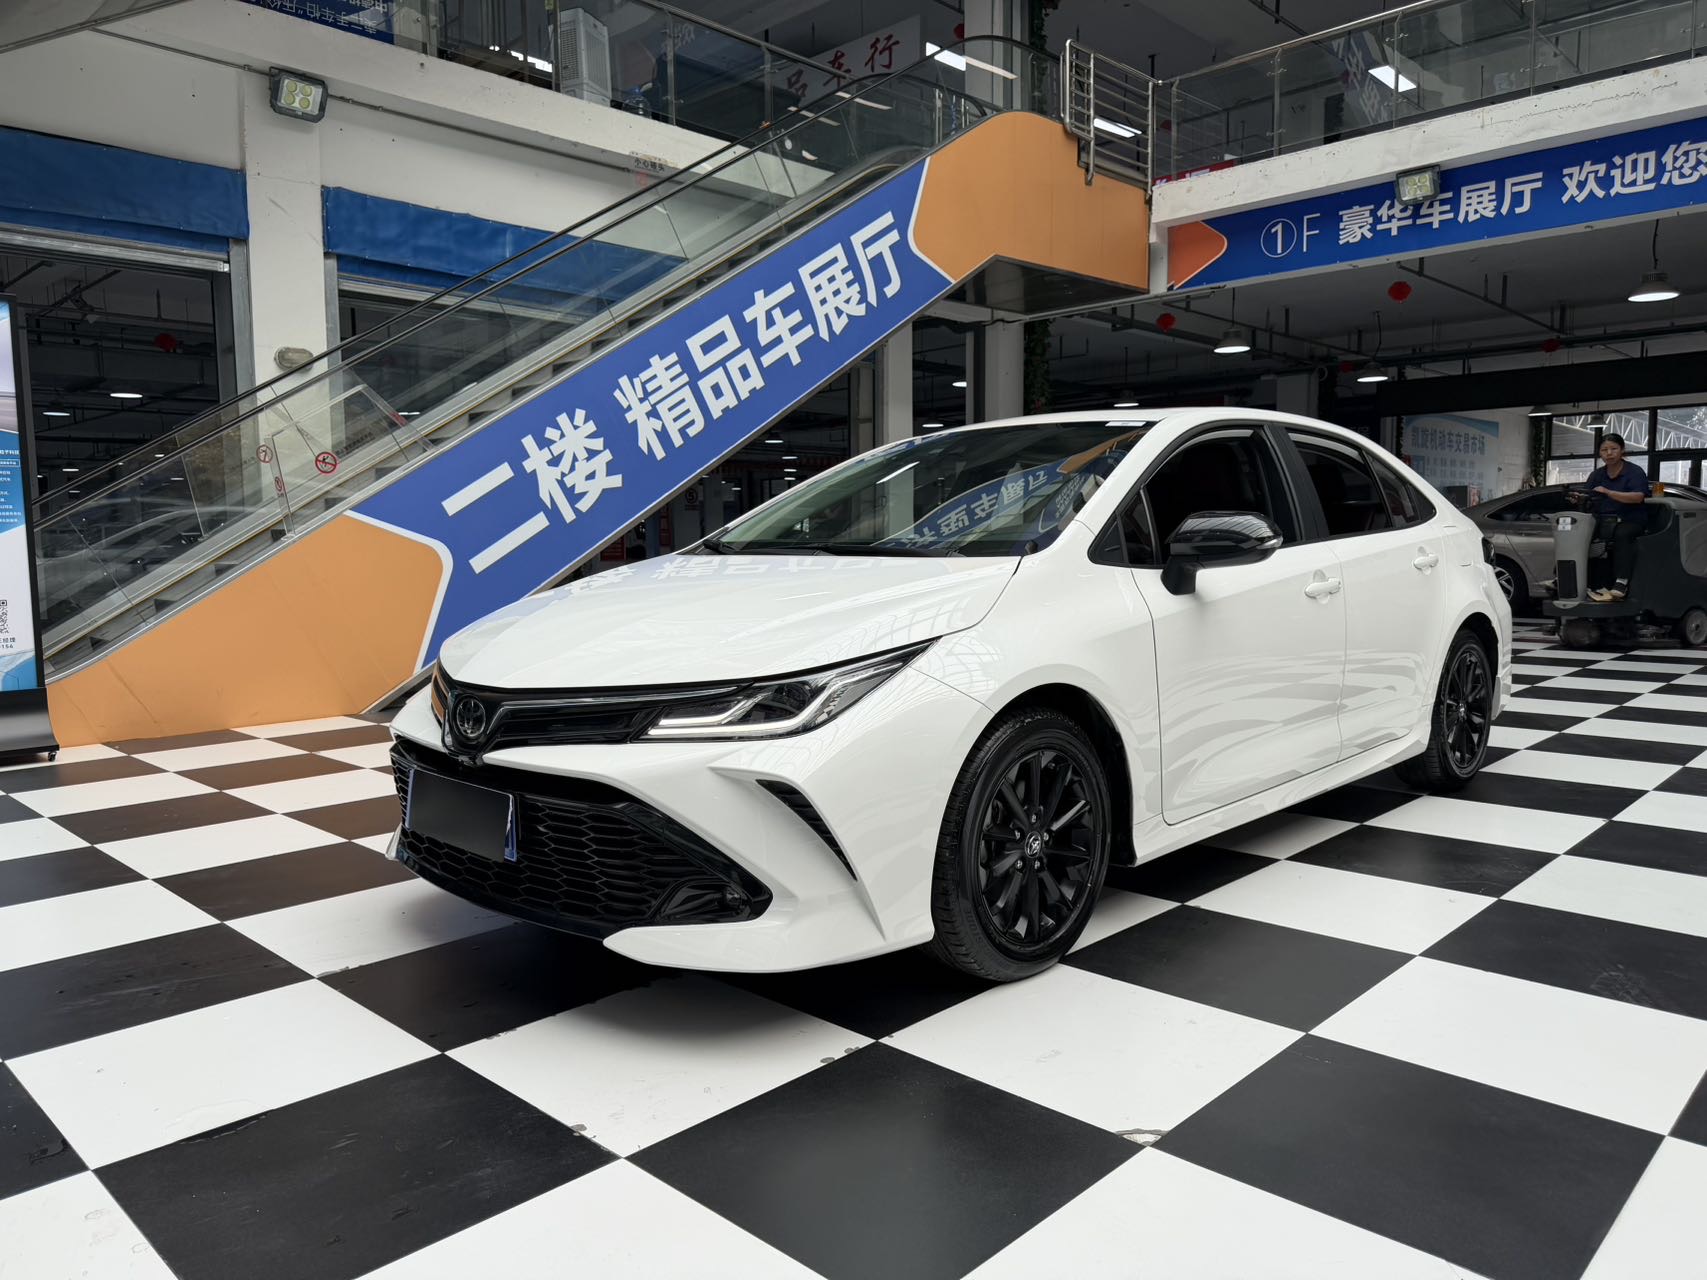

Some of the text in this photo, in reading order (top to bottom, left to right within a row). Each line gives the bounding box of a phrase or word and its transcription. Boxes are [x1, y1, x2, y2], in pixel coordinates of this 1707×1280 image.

[1338, 171, 1544, 245] 豪华车展厅
[1561, 140, 1707, 204] 欢迎您
[441, 211, 901, 574] 二楼 精品车展厅
